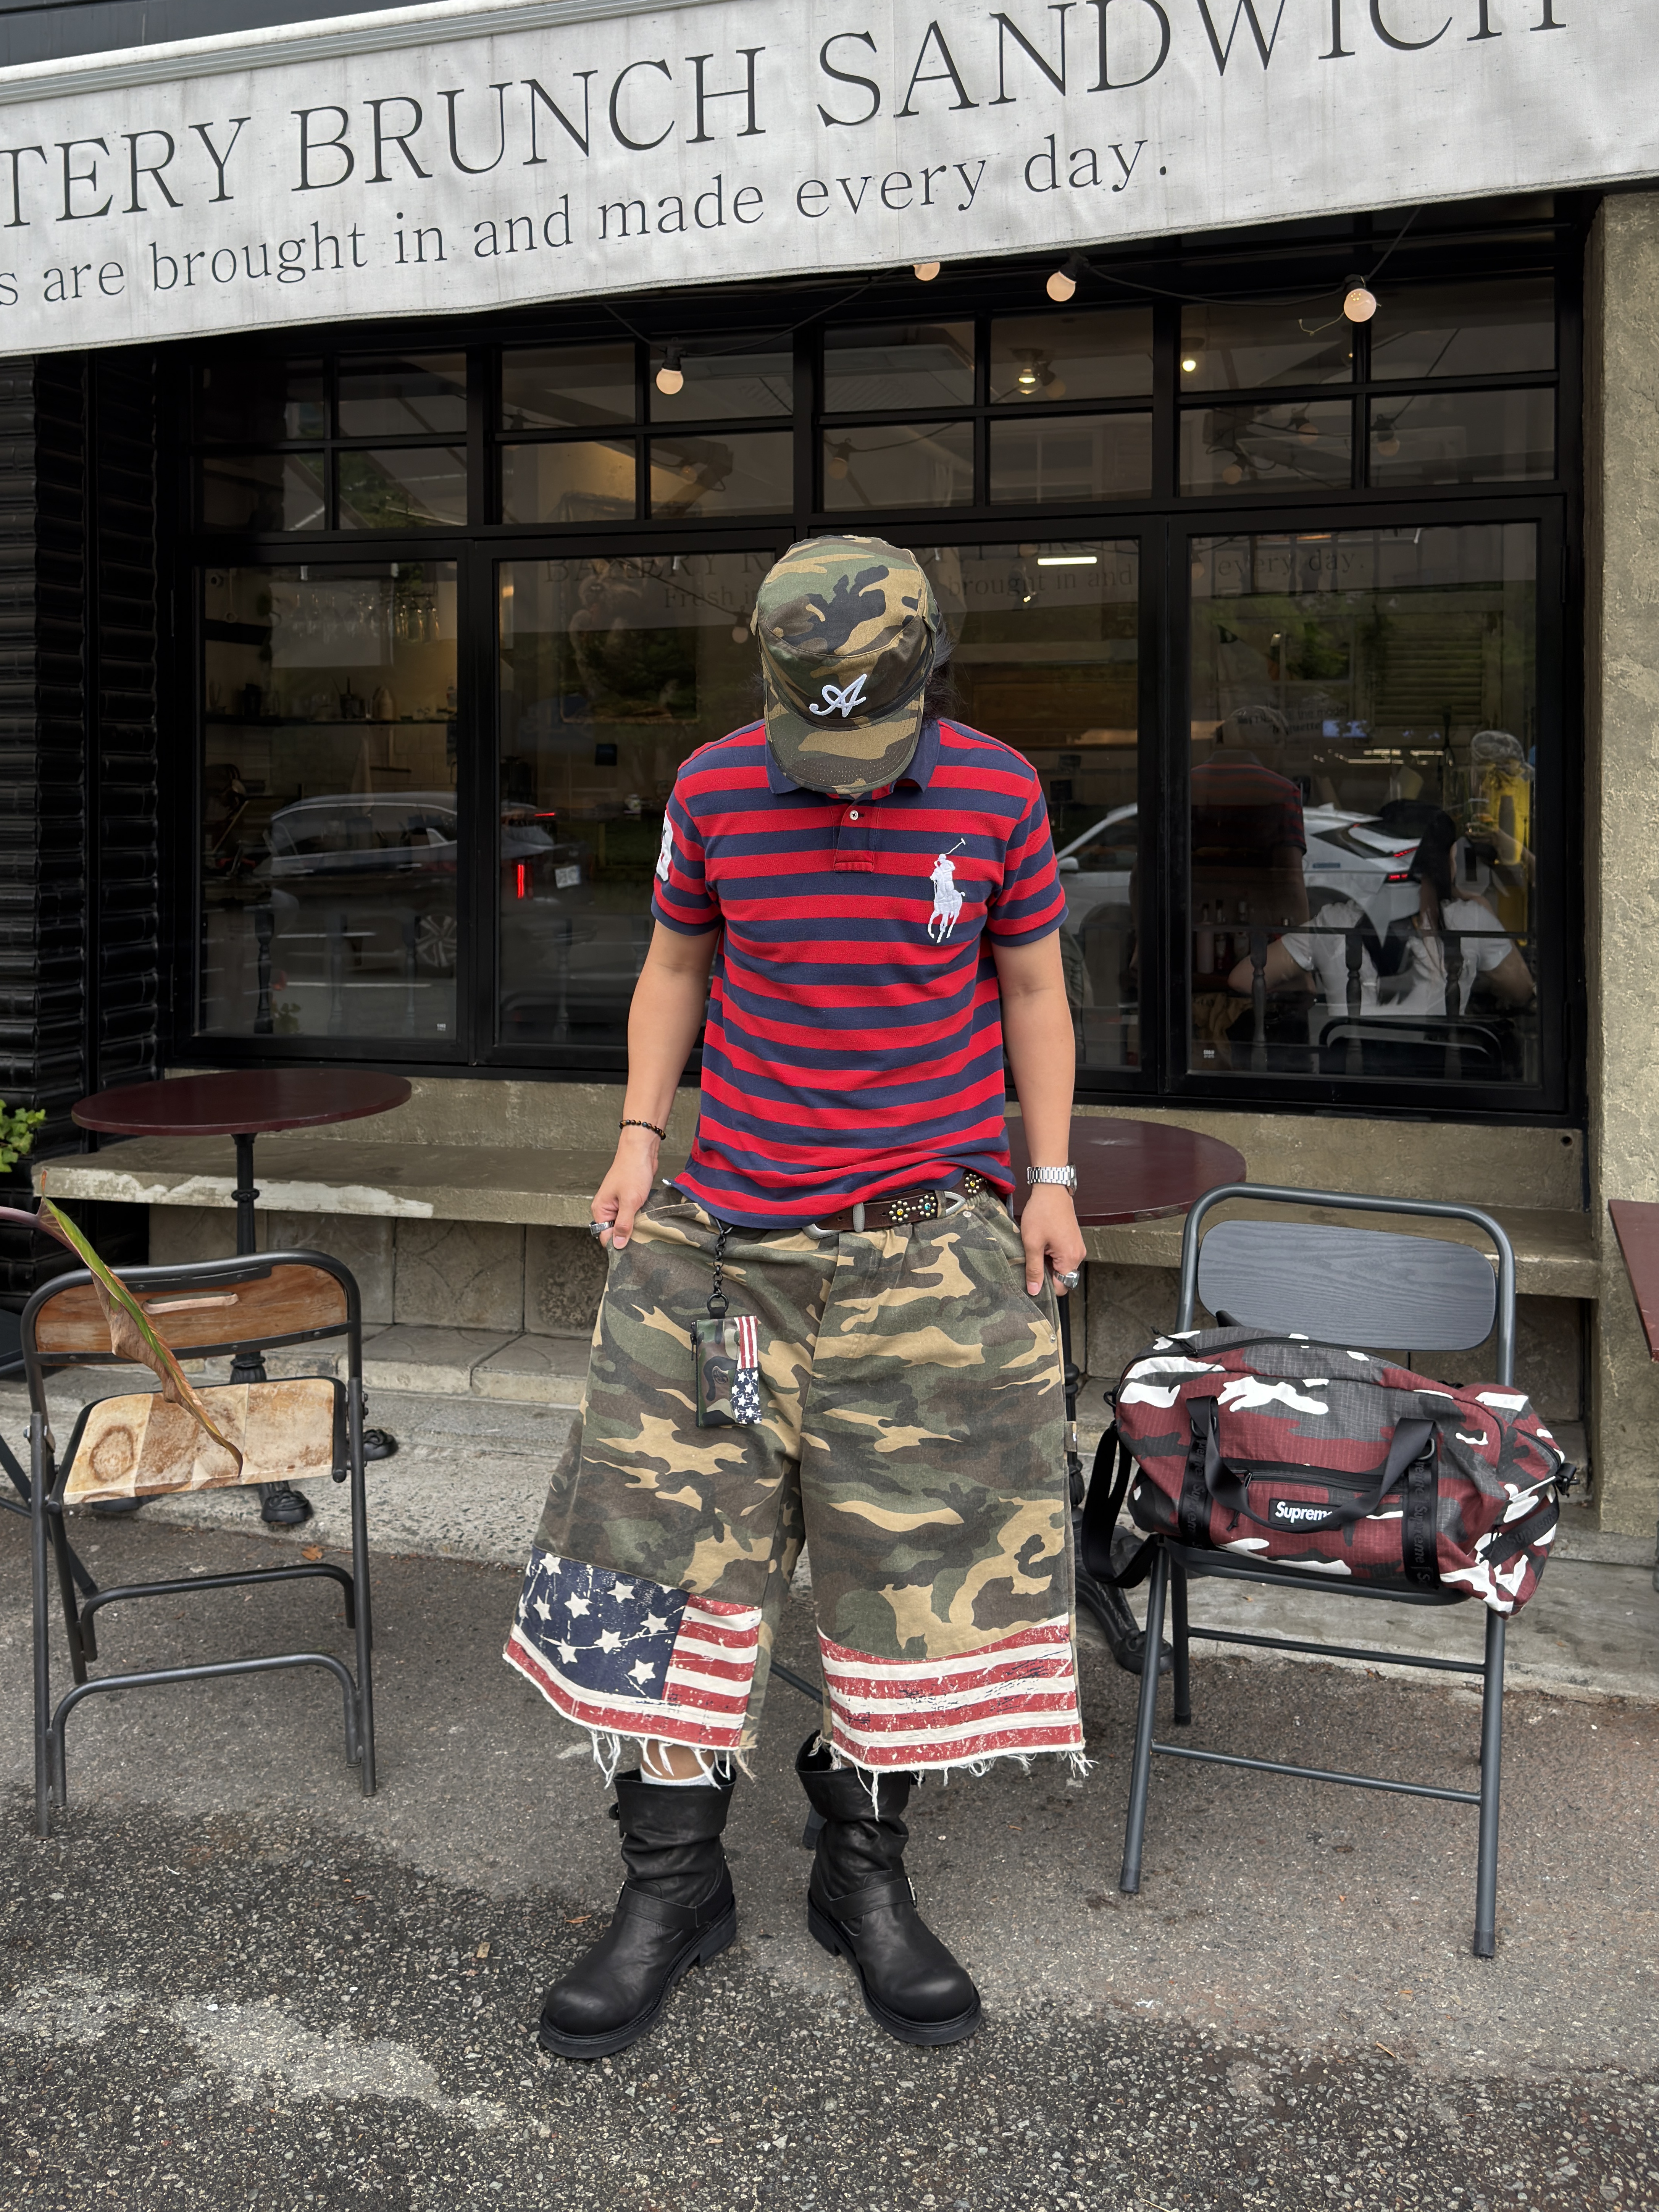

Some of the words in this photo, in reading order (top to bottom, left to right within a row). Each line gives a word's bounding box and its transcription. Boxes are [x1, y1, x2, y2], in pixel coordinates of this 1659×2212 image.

[0, 117, 251, 227] TERY
[291, 47, 766, 191] BRUNCH
[0, 273, 18, 305] s
[44, 261, 124, 302] are
[149, 221, 367, 290] brought
[394, 212, 447, 263] in
[474, 194, 573, 257] and
[598, 174, 763, 239] made
[797, 160, 986, 218] every
[1025, 134, 1166, 192] day.
[1056, 567, 1076, 590] in
[1088, 563, 1133, 588] and
[809, 673, 867, 718] A
[1184, 1483, 1205, 1532] Suprem
[1409, 1505, 1428, 1563] Supreme
